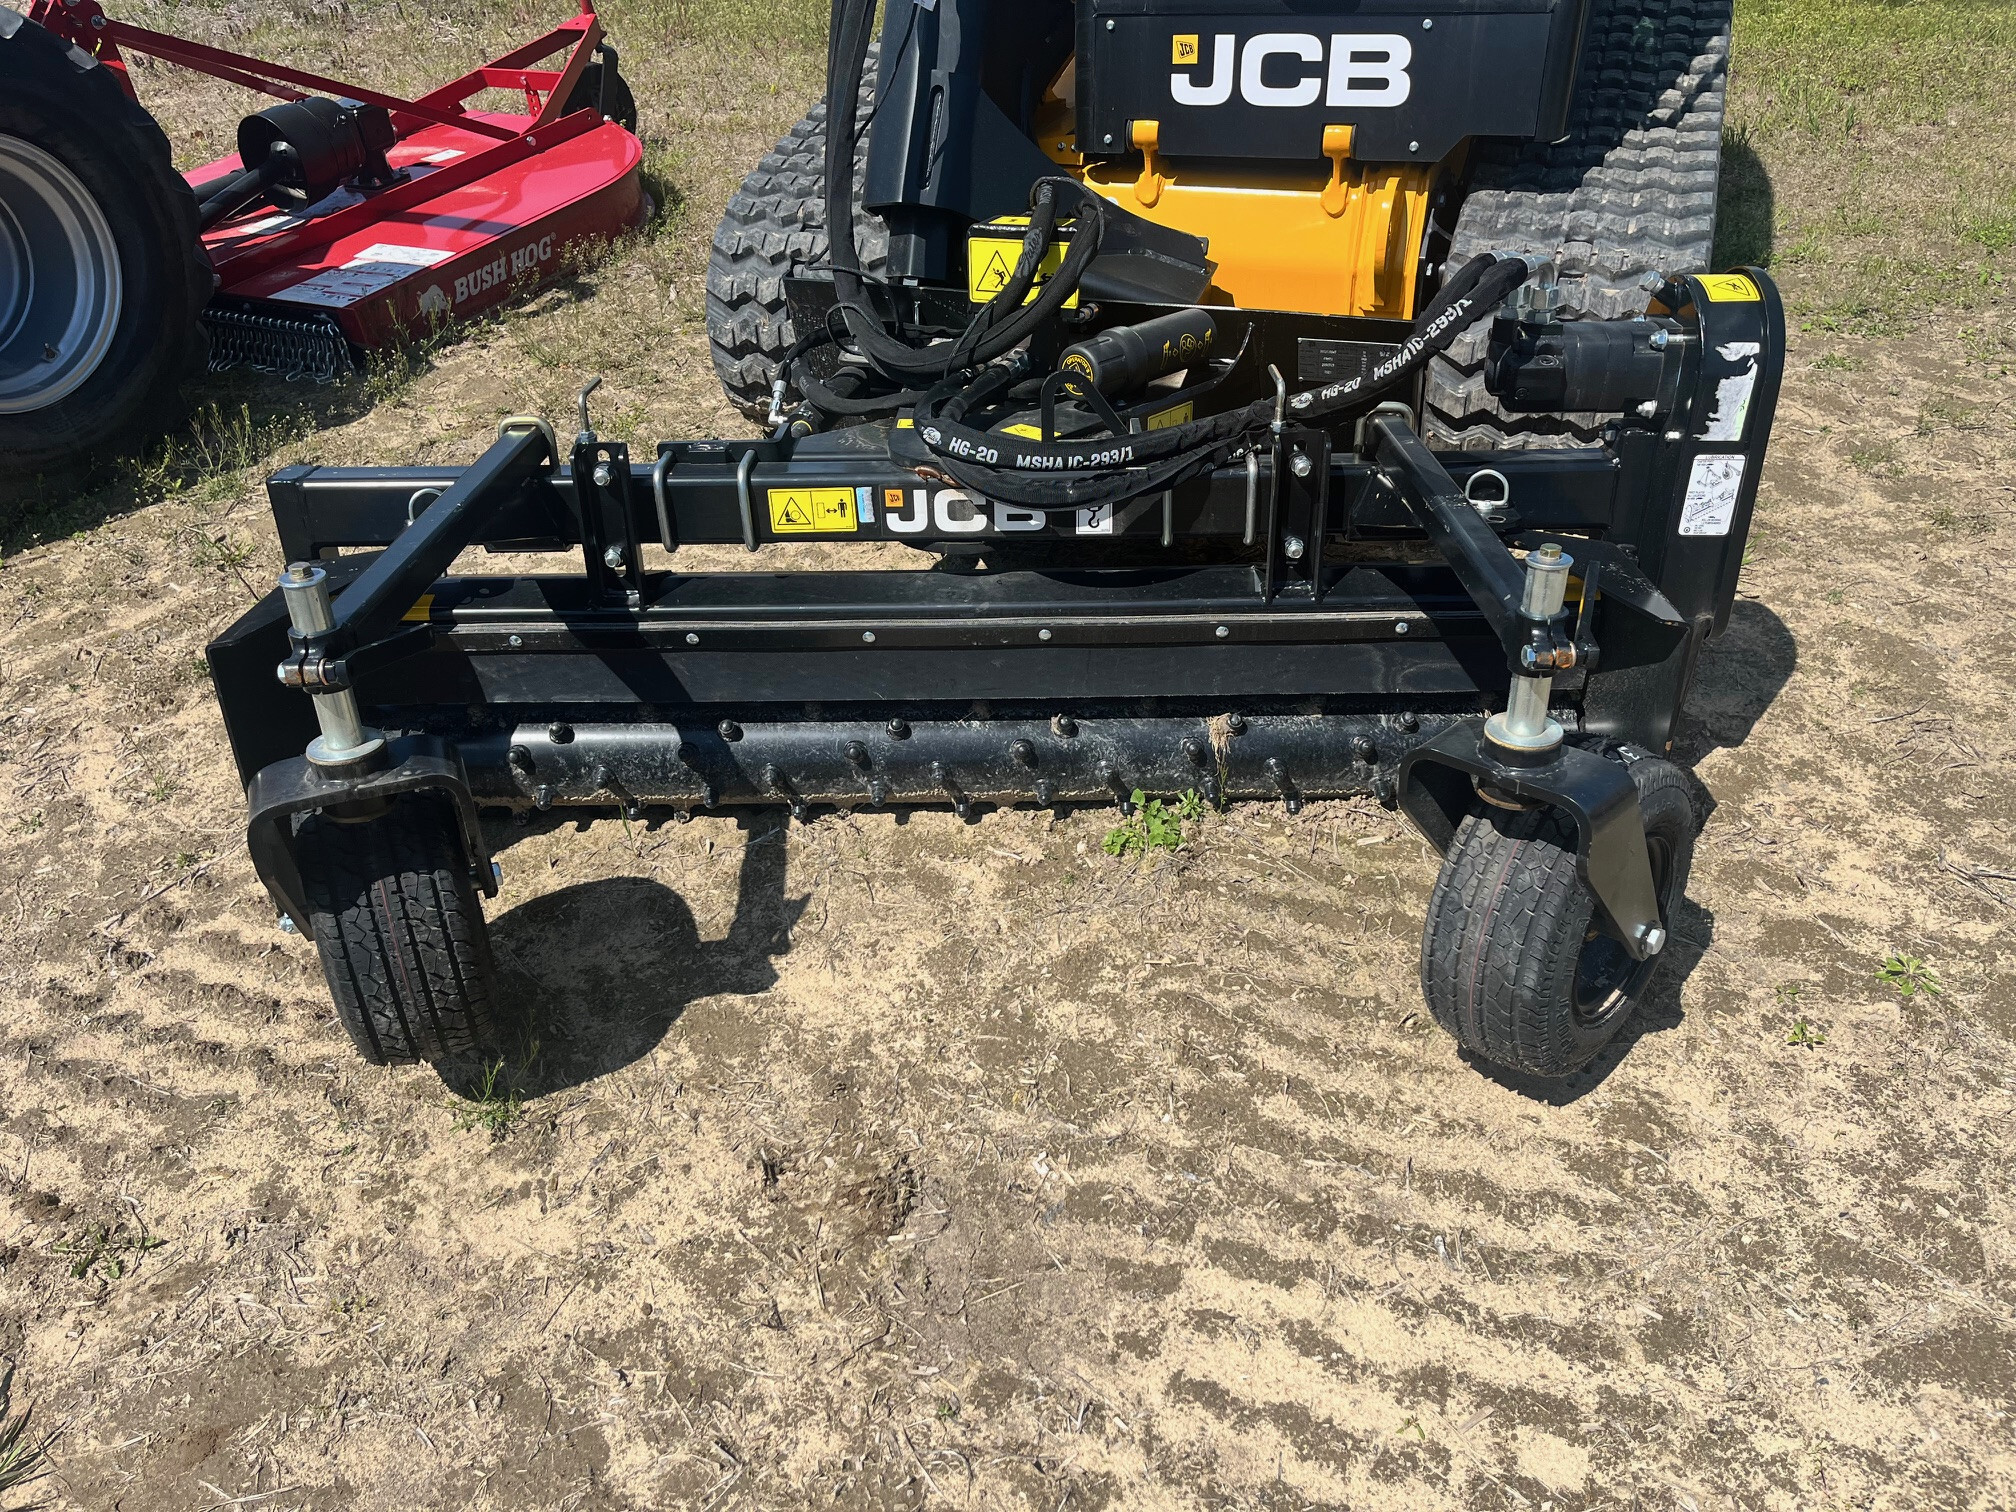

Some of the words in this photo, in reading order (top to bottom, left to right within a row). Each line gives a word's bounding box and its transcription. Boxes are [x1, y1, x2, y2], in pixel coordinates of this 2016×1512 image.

[1170, 33, 1412, 107] JCB
[1178, 42, 1195, 58] JCB
[454, 256, 507, 304] BUSH
[1321, 376, 1362, 400] HG-20
[1373, 348, 1412, 381] MSHA
[948, 436, 998, 464] HG-20
[1016, 454, 1064, 470] MSHA
[1067, 445, 1135, 470] IC-293/1
[886, 488, 1047, 533] JCB
